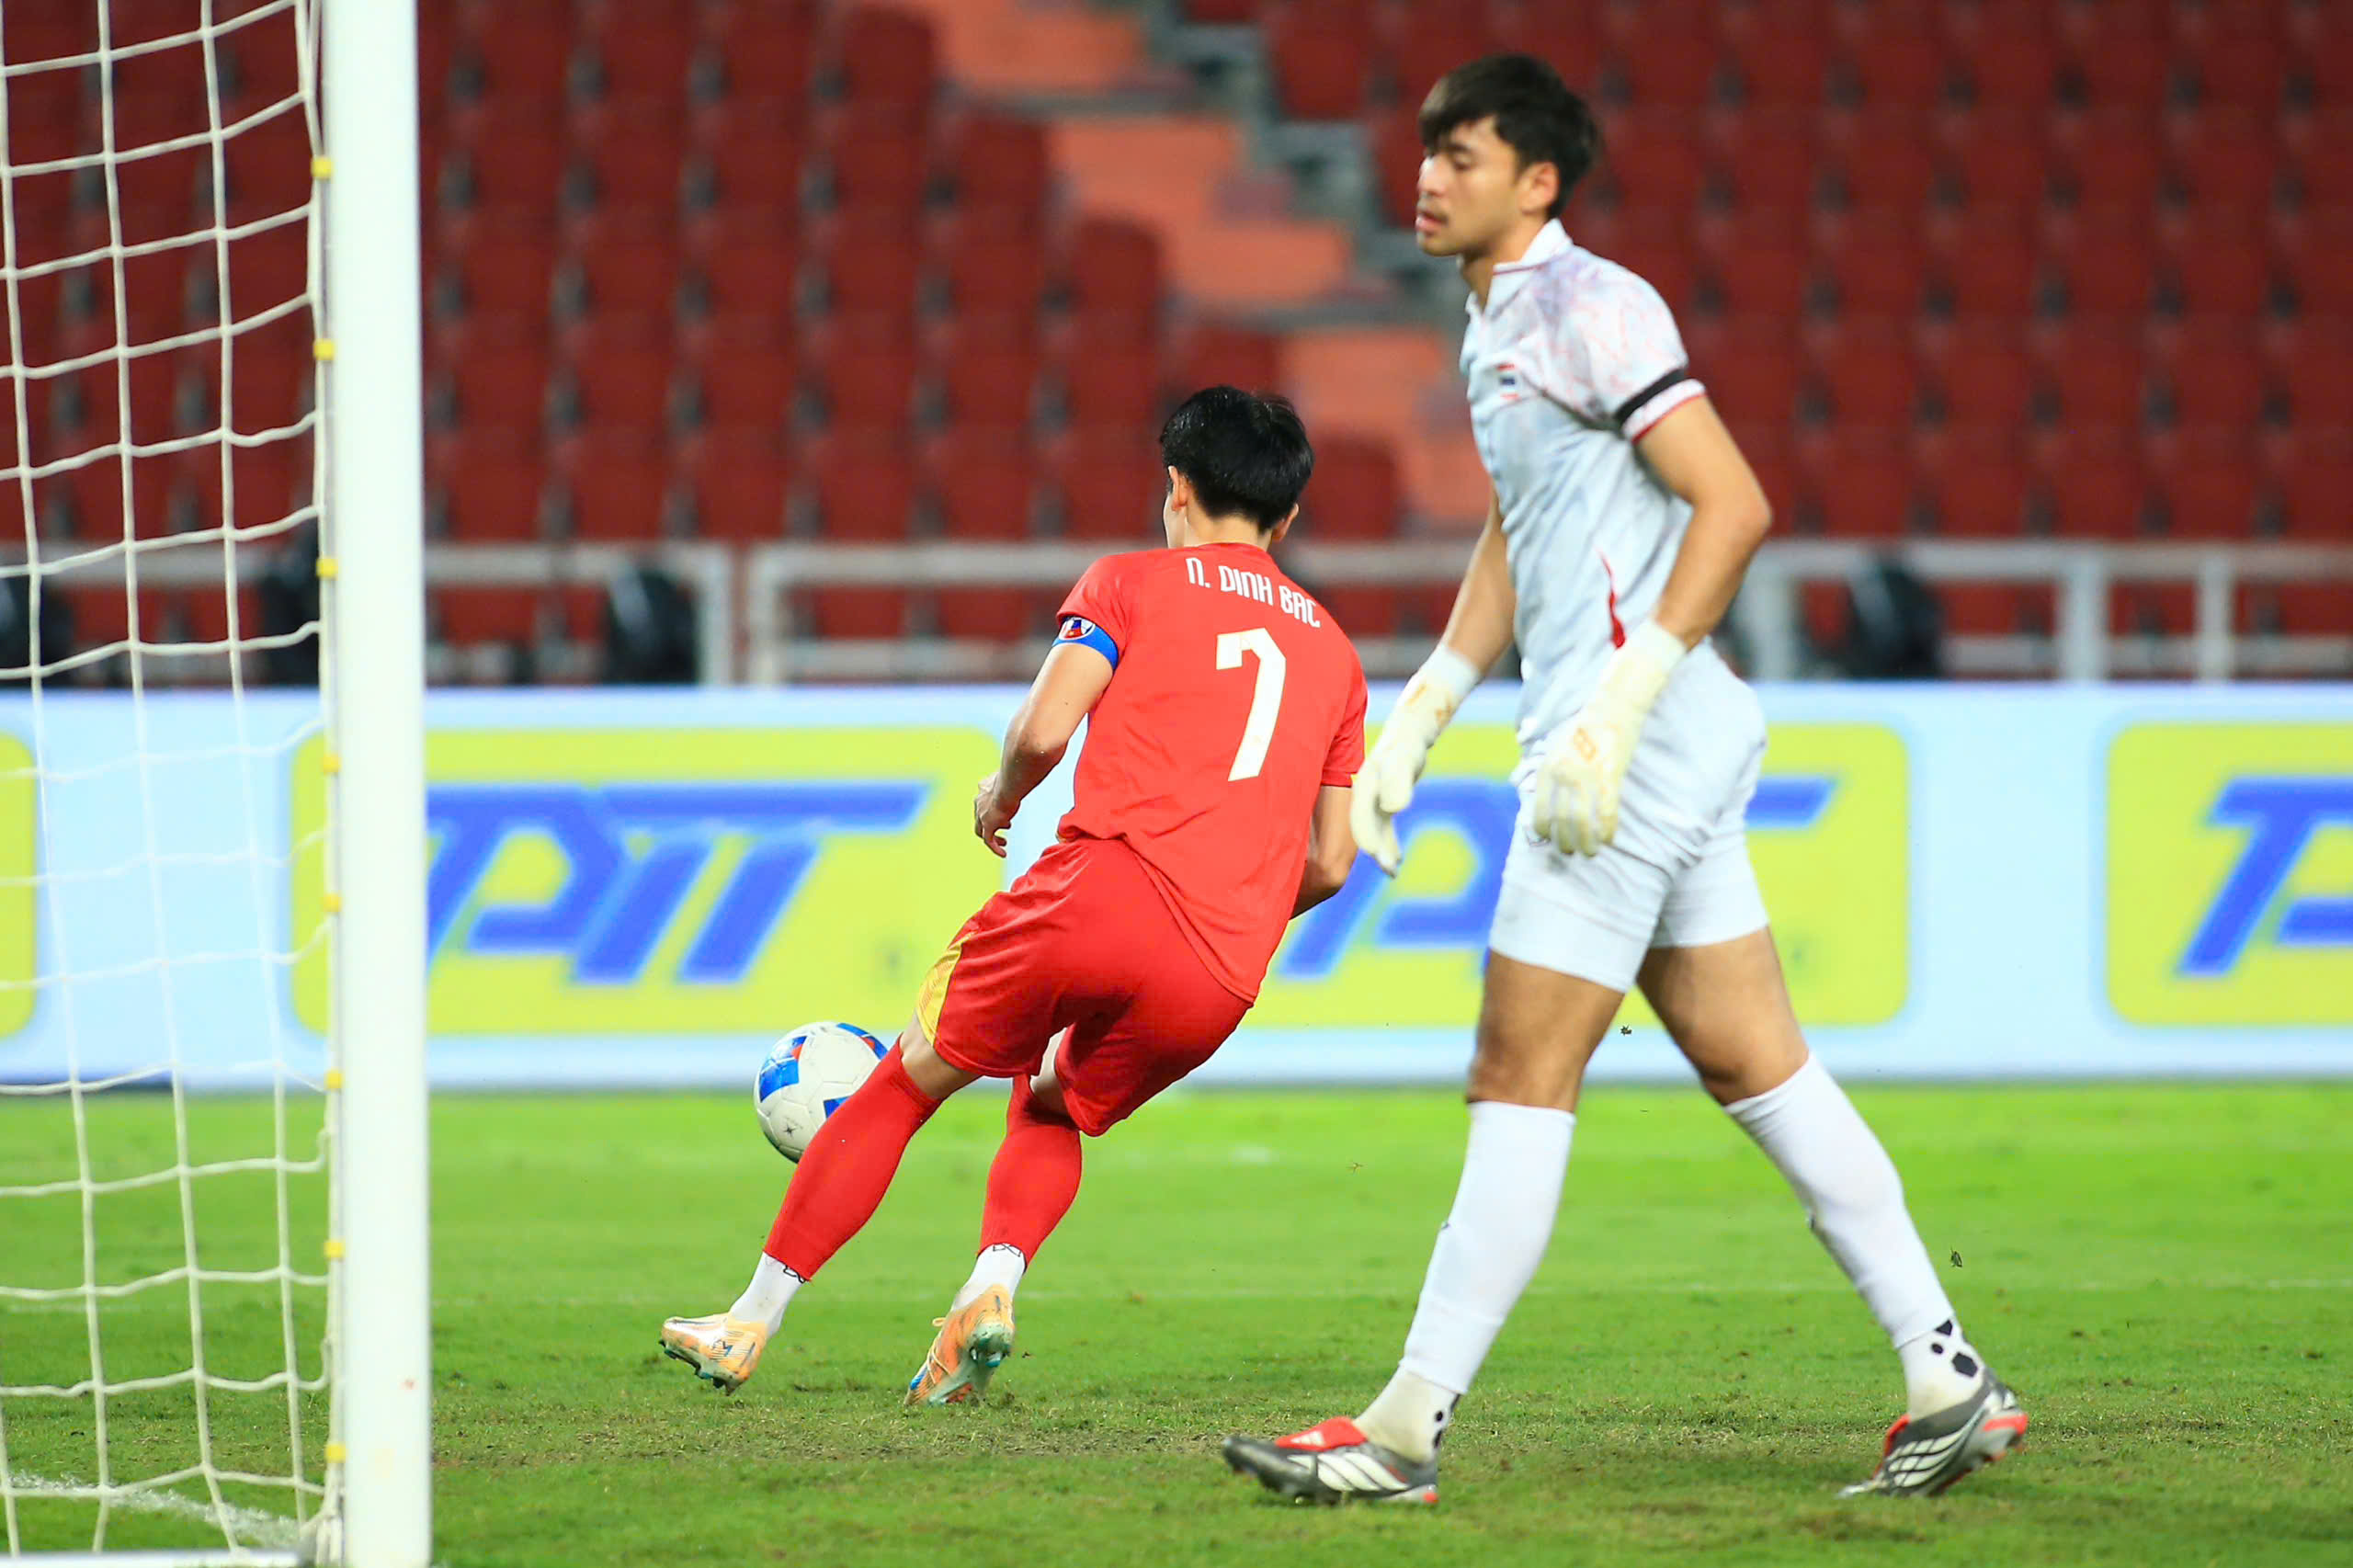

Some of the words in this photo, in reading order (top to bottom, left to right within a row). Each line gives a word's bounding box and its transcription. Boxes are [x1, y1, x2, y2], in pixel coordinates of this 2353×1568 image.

[1218, 565, 1274, 607] DINH
[1279, 585, 1322, 629] BAC
[1216, 627, 1287, 782] 7
[426, 781, 932, 983] PTT
